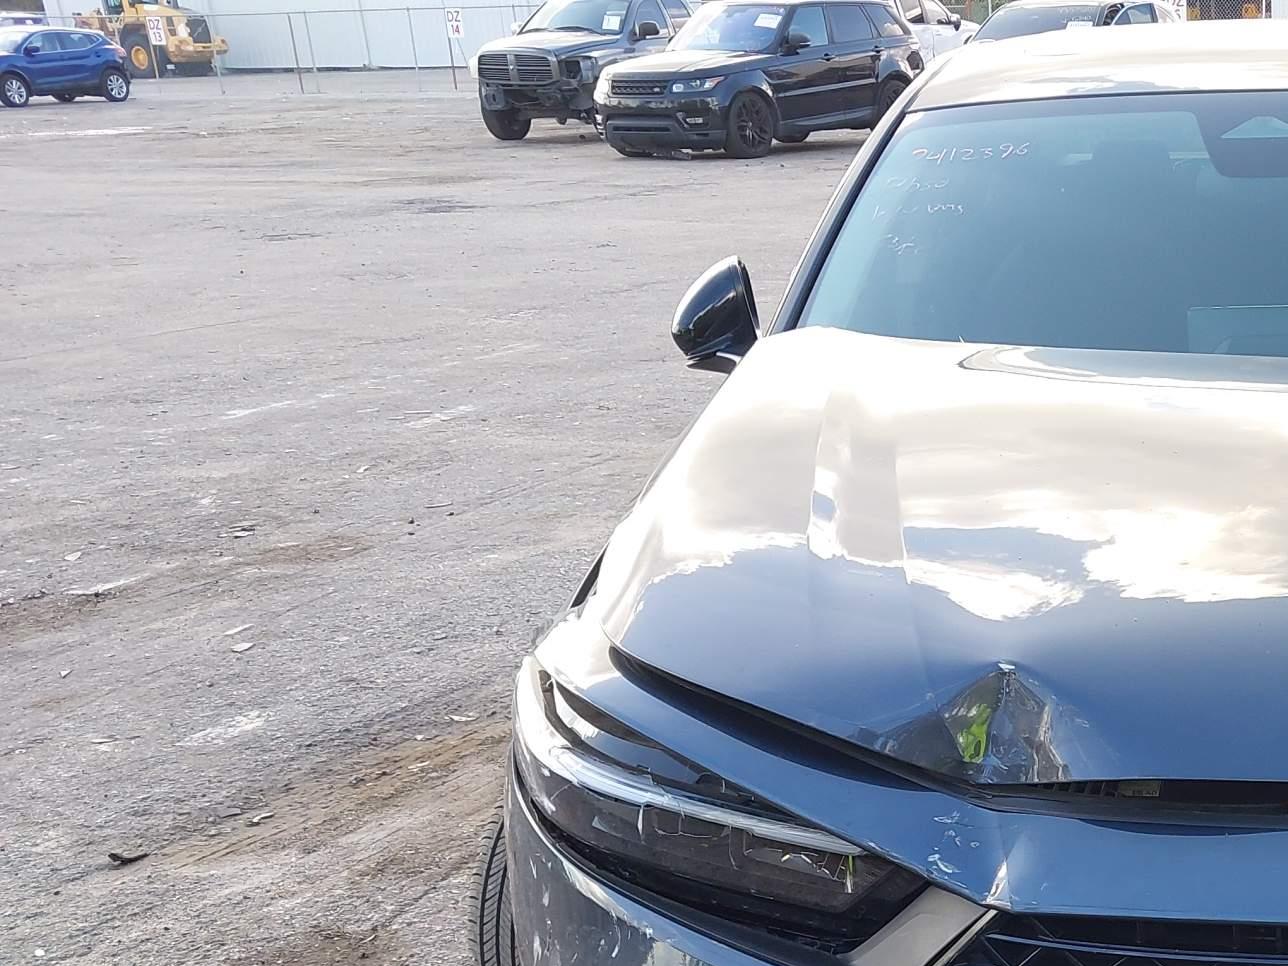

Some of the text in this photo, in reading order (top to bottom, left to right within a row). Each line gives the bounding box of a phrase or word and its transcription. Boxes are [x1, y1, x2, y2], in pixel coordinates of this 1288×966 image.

[446, 10, 461, 22] DZ
[147, 19, 162, 30] DZ
[450, 24, 461, 36] 14
[152, 31, 163, 42] 13
